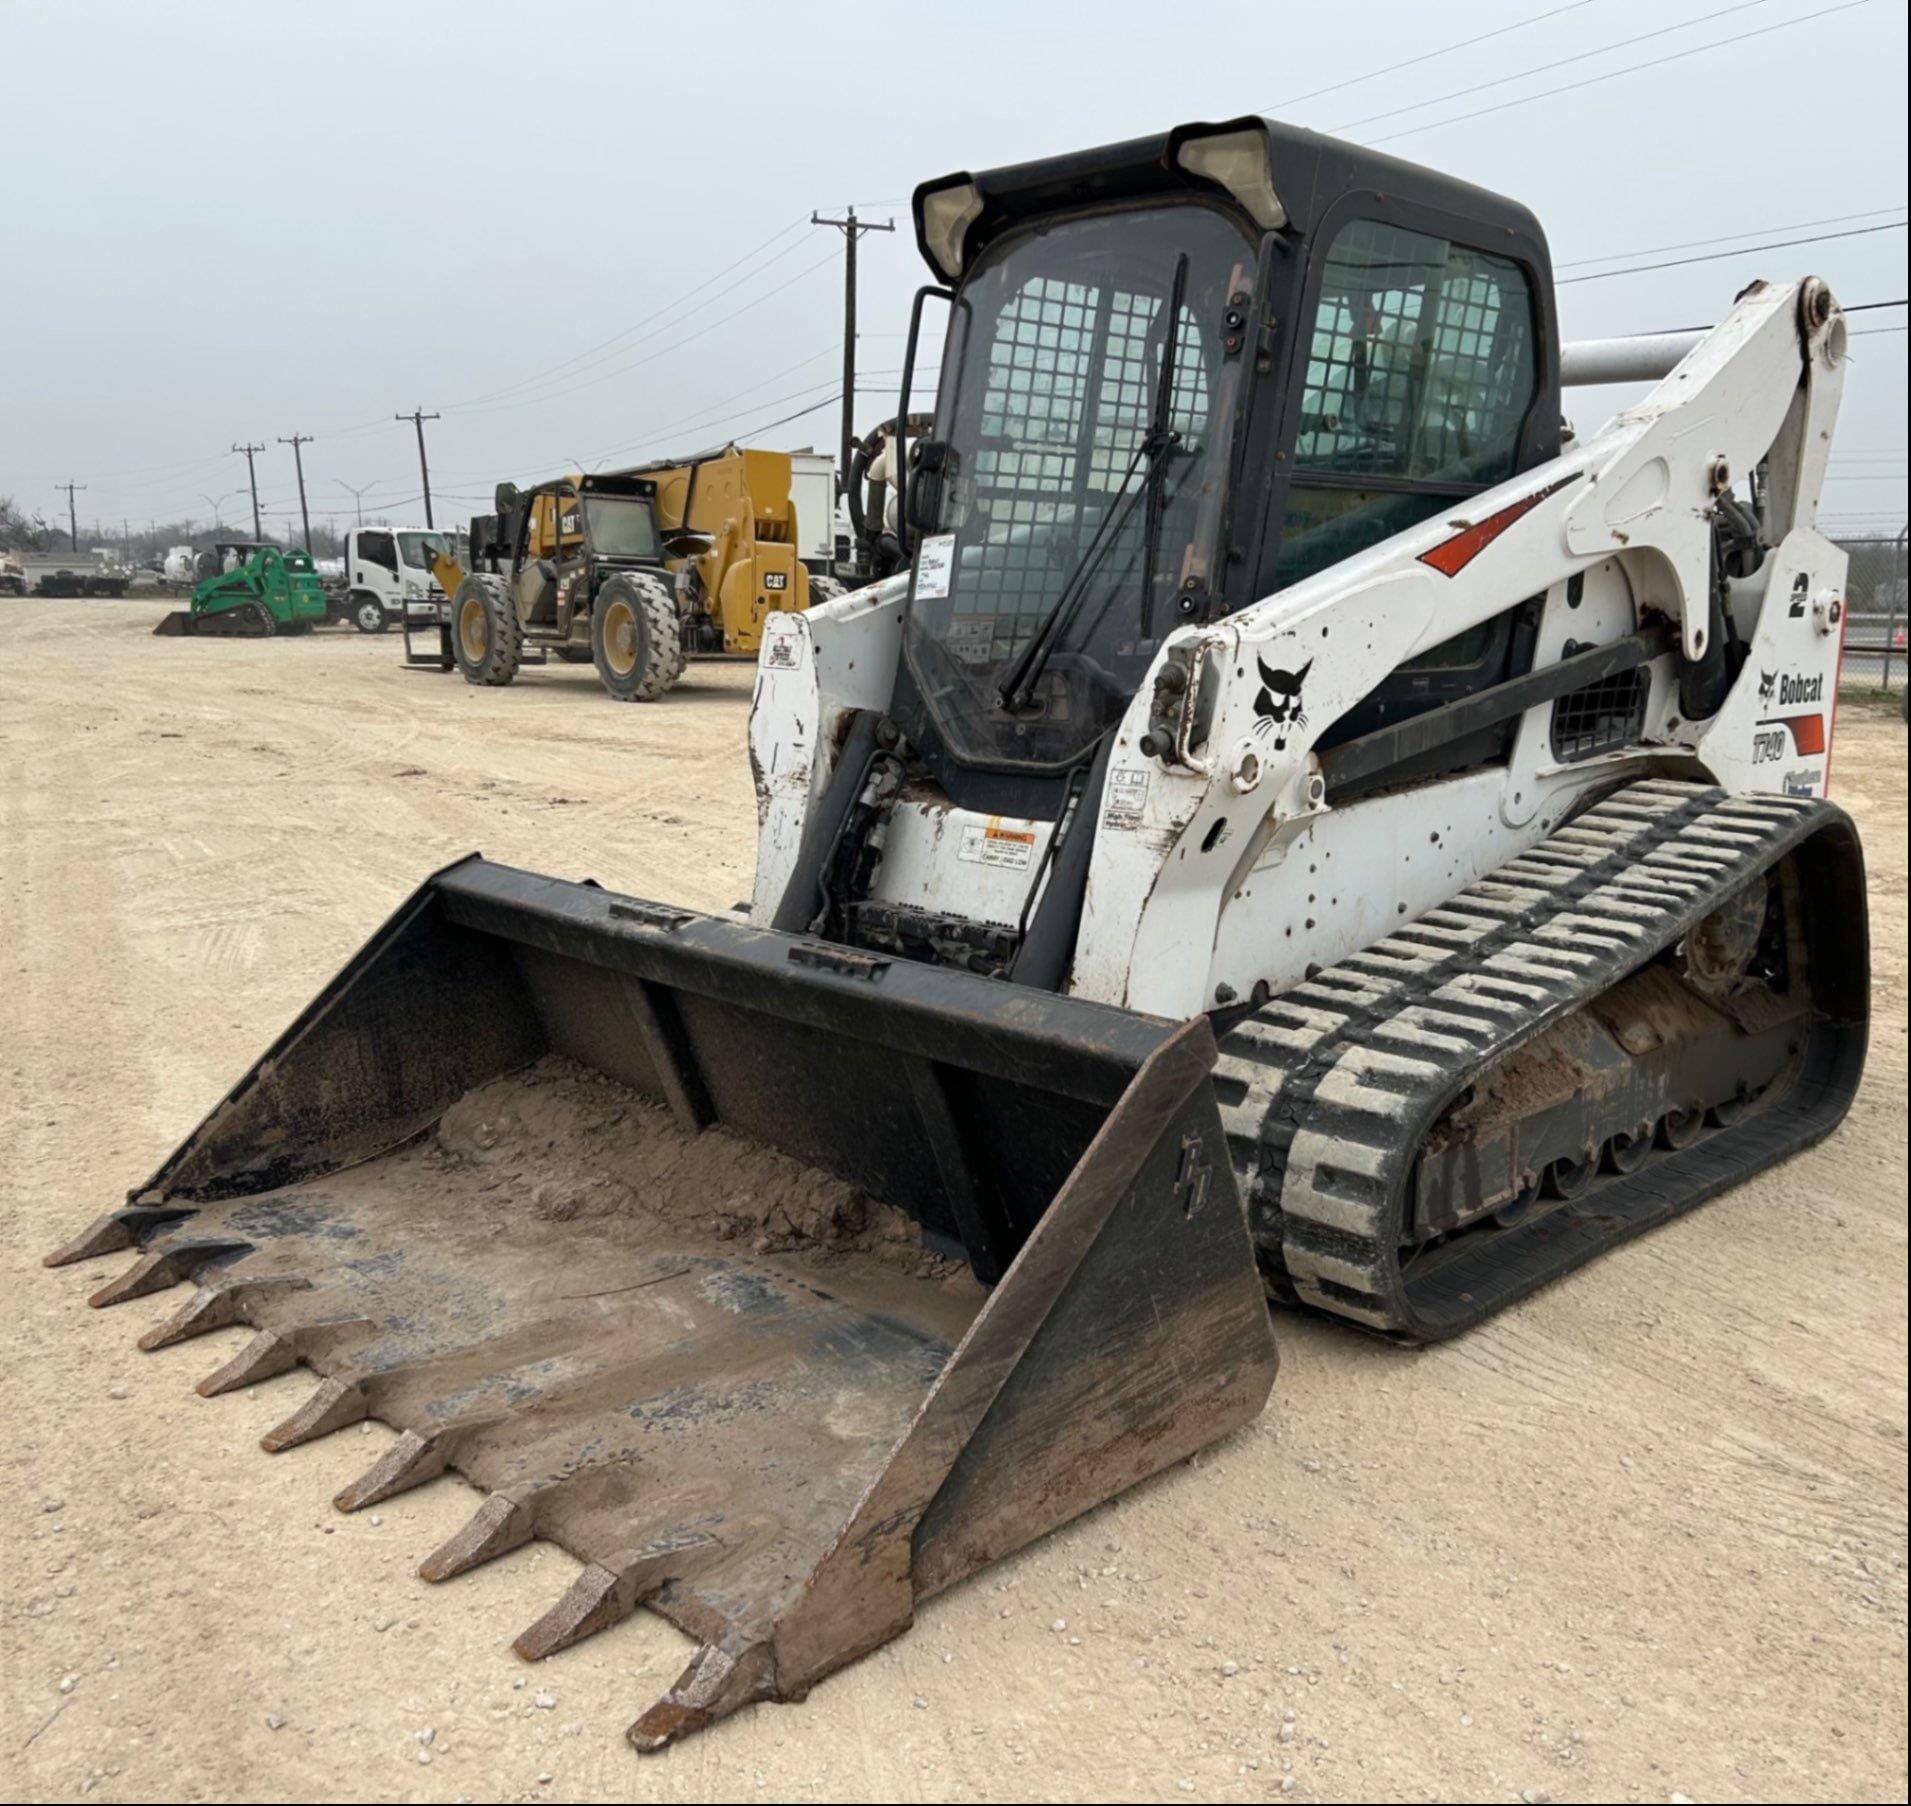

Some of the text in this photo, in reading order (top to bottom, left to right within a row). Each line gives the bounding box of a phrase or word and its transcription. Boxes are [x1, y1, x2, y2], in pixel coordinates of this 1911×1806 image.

[562, 515, 575, 534] CAT
[766, 574, 785, 588] CAT
[1788, 572, 1809, 618] 2
[1779, 673, 1822, 705] Bobcat
[1752, 730, 1786, 764] T740
